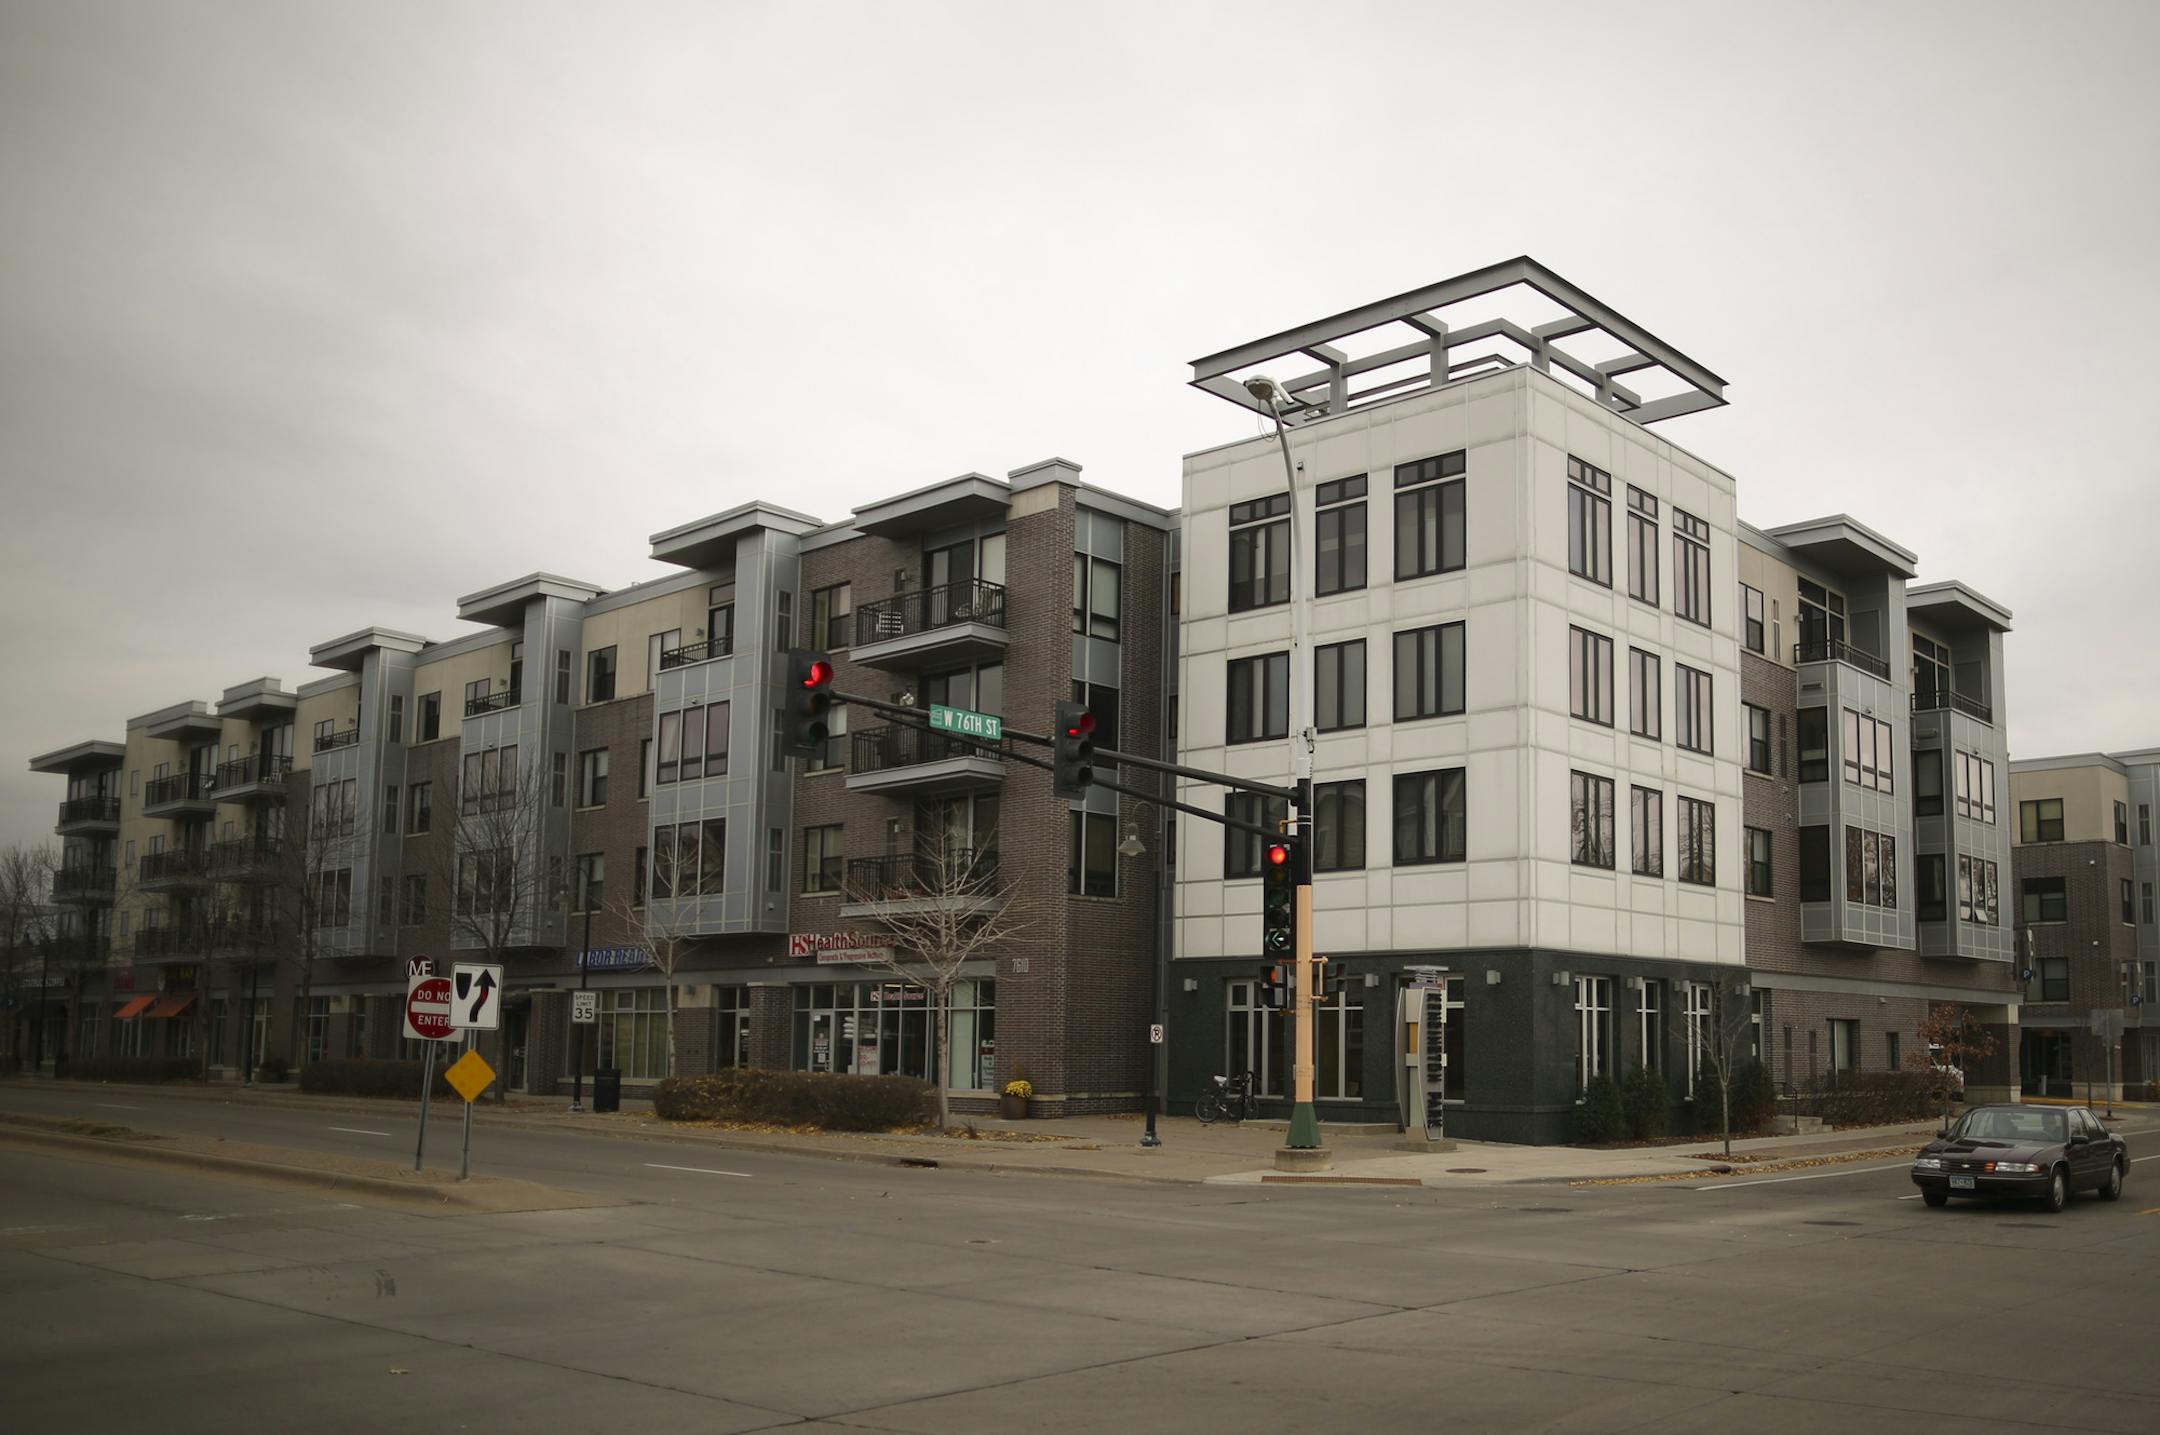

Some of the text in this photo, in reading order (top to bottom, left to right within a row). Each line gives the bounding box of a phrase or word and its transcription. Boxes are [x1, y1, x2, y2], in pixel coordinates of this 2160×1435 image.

[944, 709, 953, 727] W
[956, 712, 982, 733] 76TH
[986, 719, 997, 736] ST
[808, 931, 896, 951] HealthSource
[1012, 958, 1028, 973] 7610
[417, 990, 451, 1001] DO NO
[574, 1007, 593, 1019] 35
